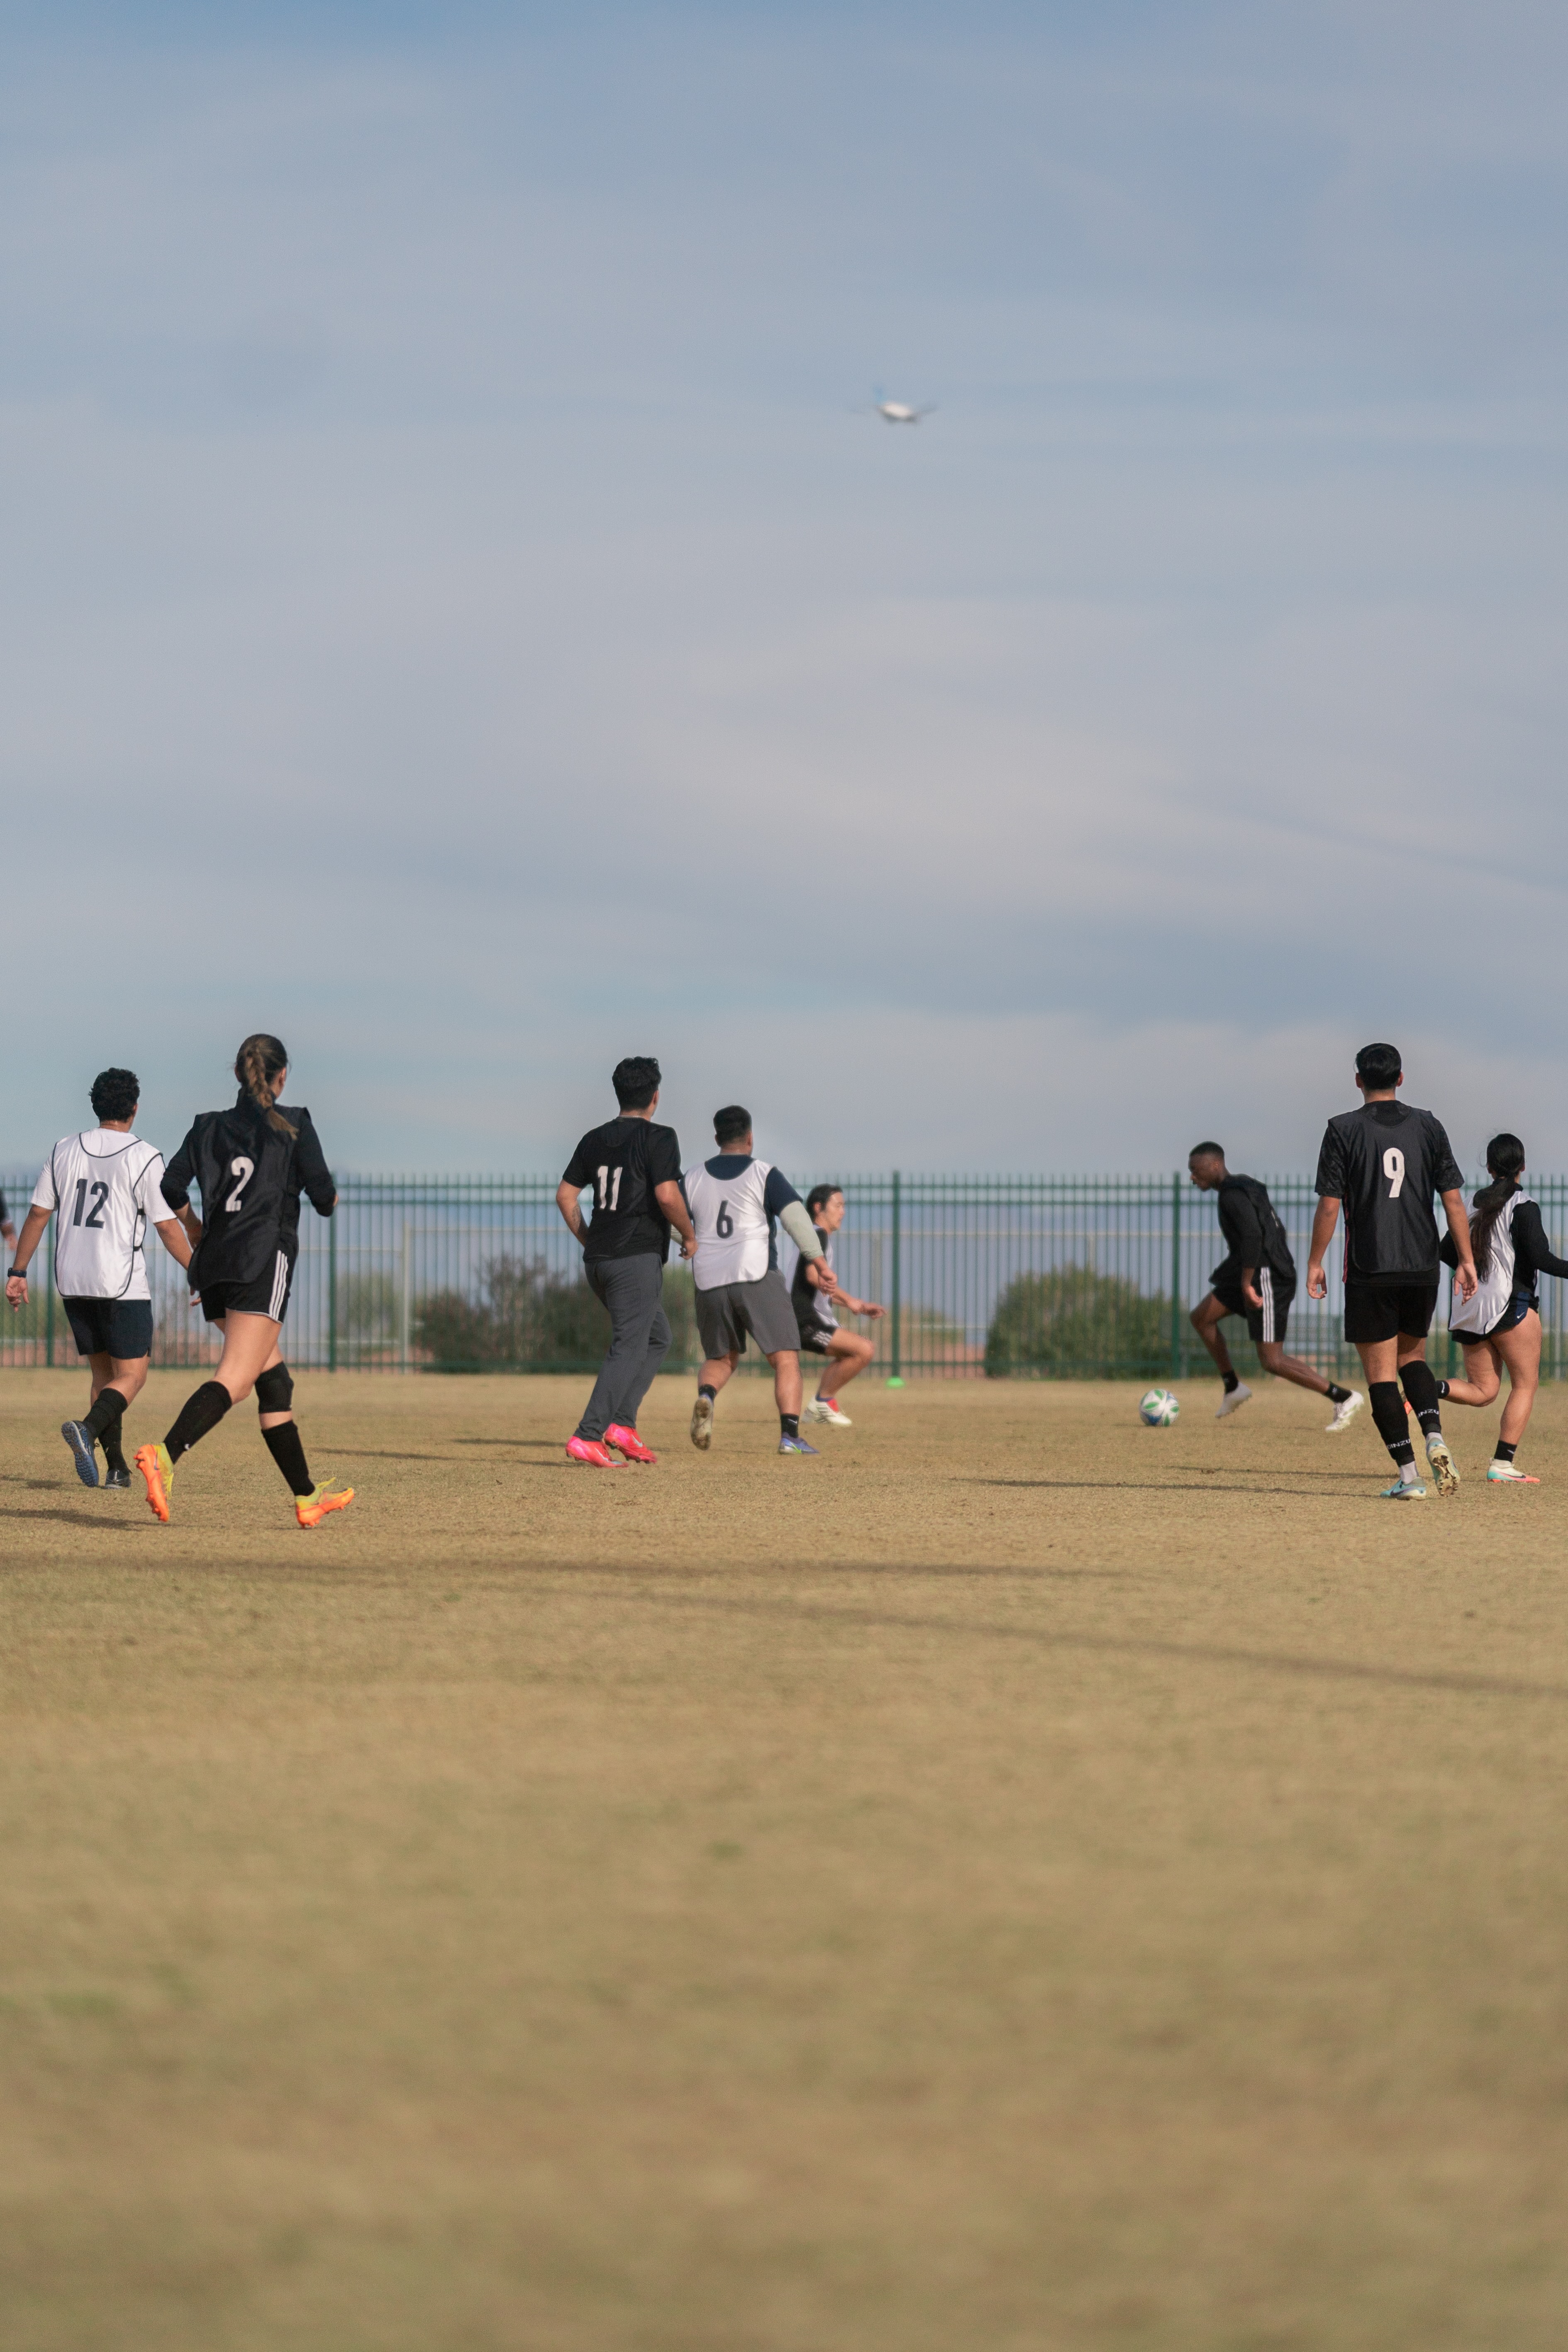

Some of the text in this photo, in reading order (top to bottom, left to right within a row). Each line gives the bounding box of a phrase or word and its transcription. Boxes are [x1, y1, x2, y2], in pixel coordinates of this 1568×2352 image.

[225, 1156, 255, 1212] 2
[597, 1165, 623, 1211] 11
[1383, 1147, 1405, 1198] 9
[73, 1178, 109, 1228] 12
[716, 1199, 734, 1239] 6
